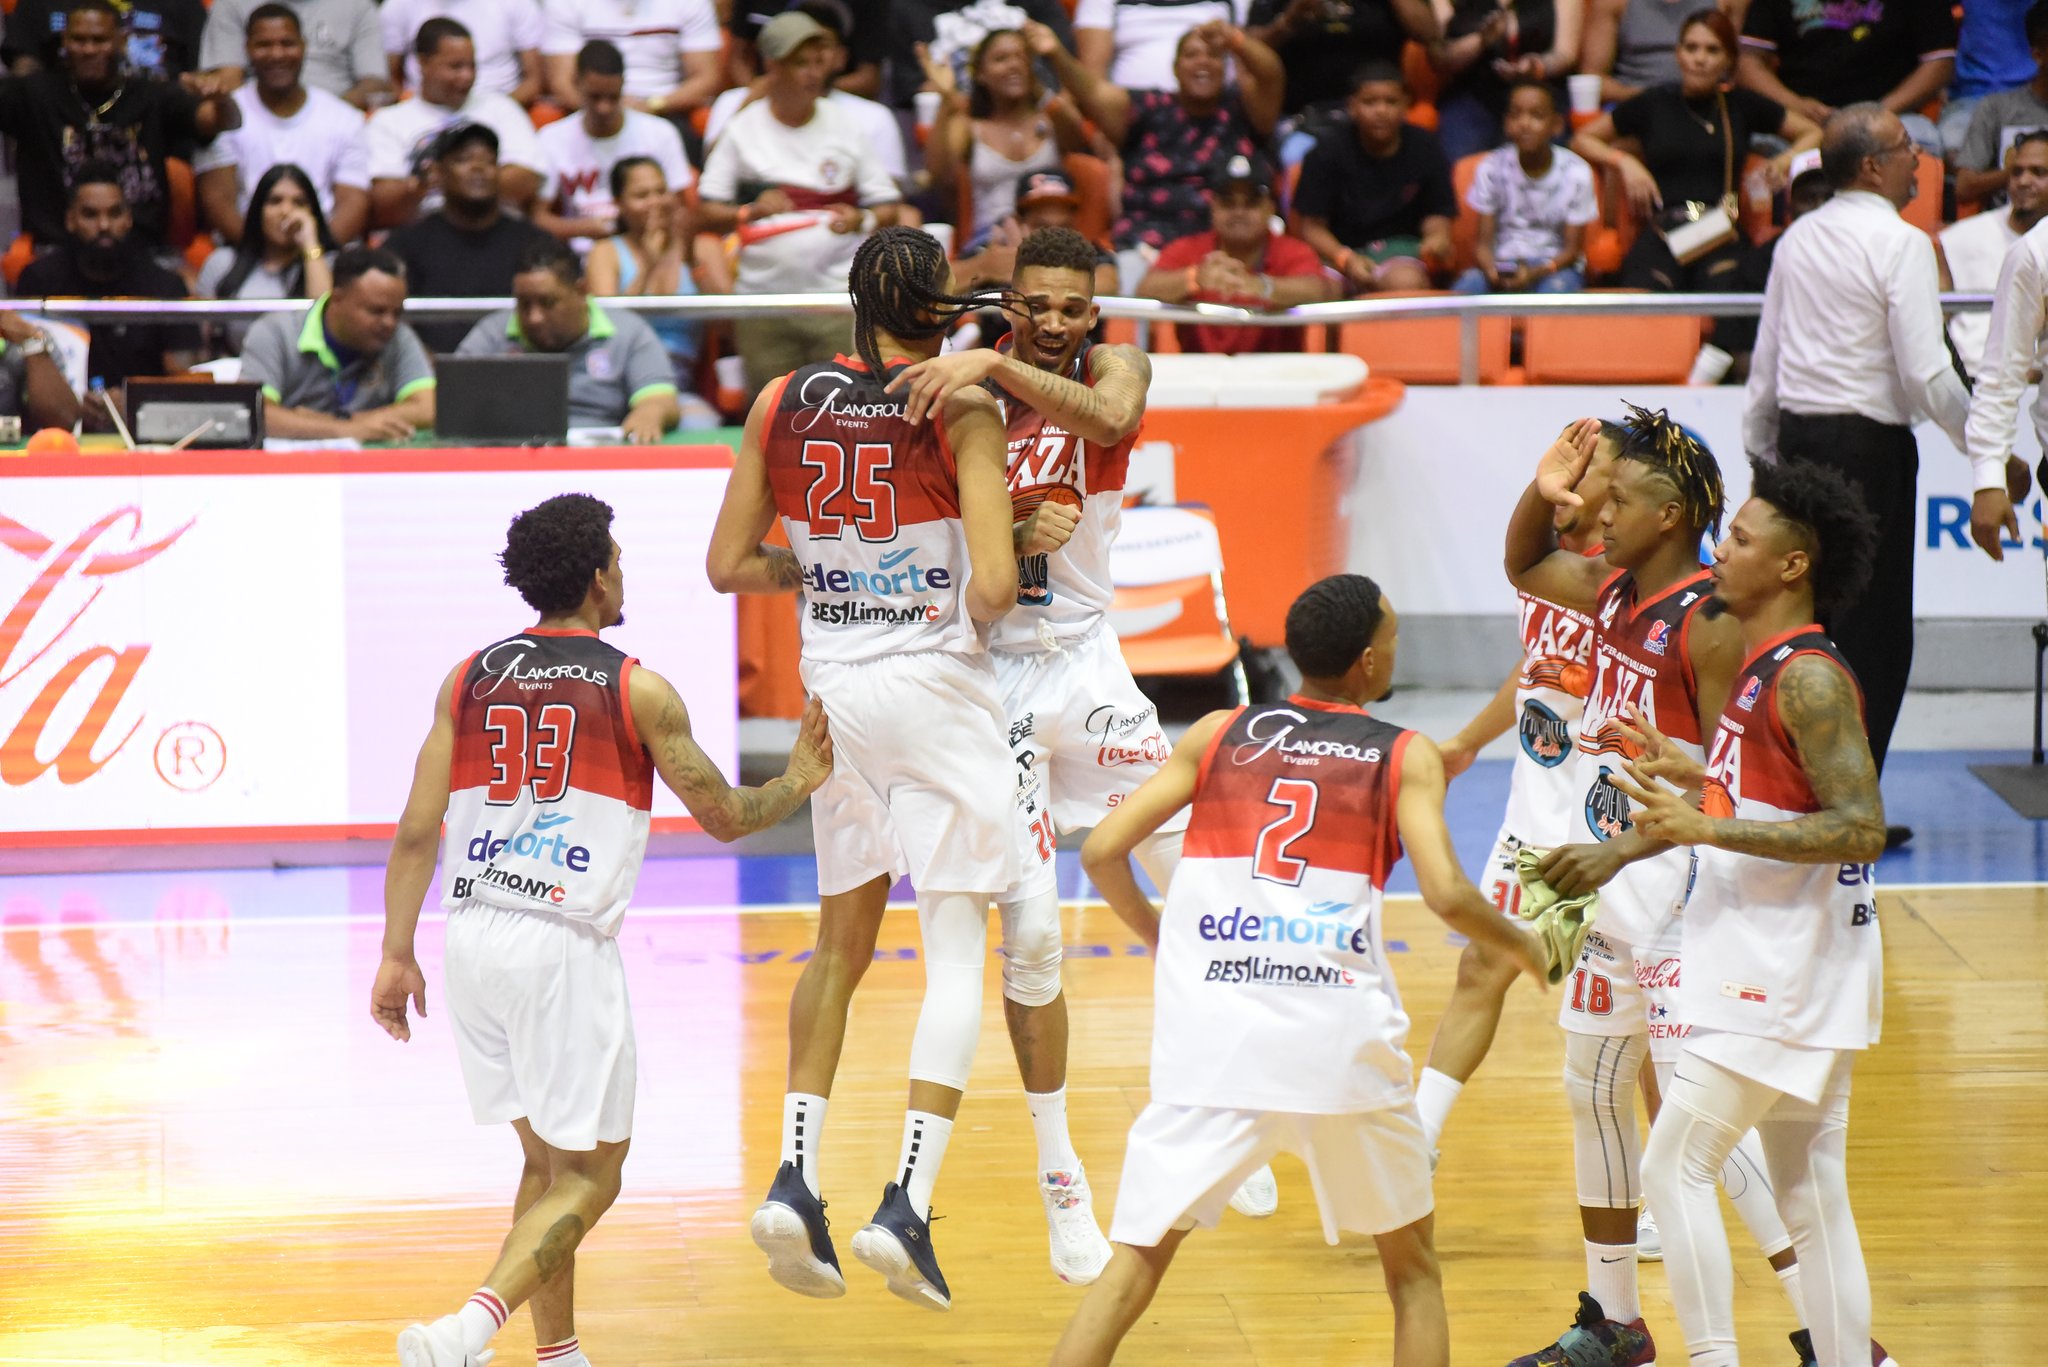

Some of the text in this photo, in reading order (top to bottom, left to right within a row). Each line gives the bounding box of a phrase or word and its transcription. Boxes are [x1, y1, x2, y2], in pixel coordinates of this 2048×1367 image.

[790, 371, 909, 434] GLAMOROU
[836, 418, 869, 430] EVENTS
[801, 437, 899, 544] 25
[472, 638, 609, 701] GLAMOROUS
[518, 682, 553, 691] EVENTS
[484, 702, 577, 807] 33
[1232, 708, 1382, 766] GLAMOROUS
[1282, 754, 1320, 767] EVENTS
[1251, 776, 1319, 888] 2
[1198, 906, 1368, 955] edenorte
[1570, 967, 1614, 1016] 18
